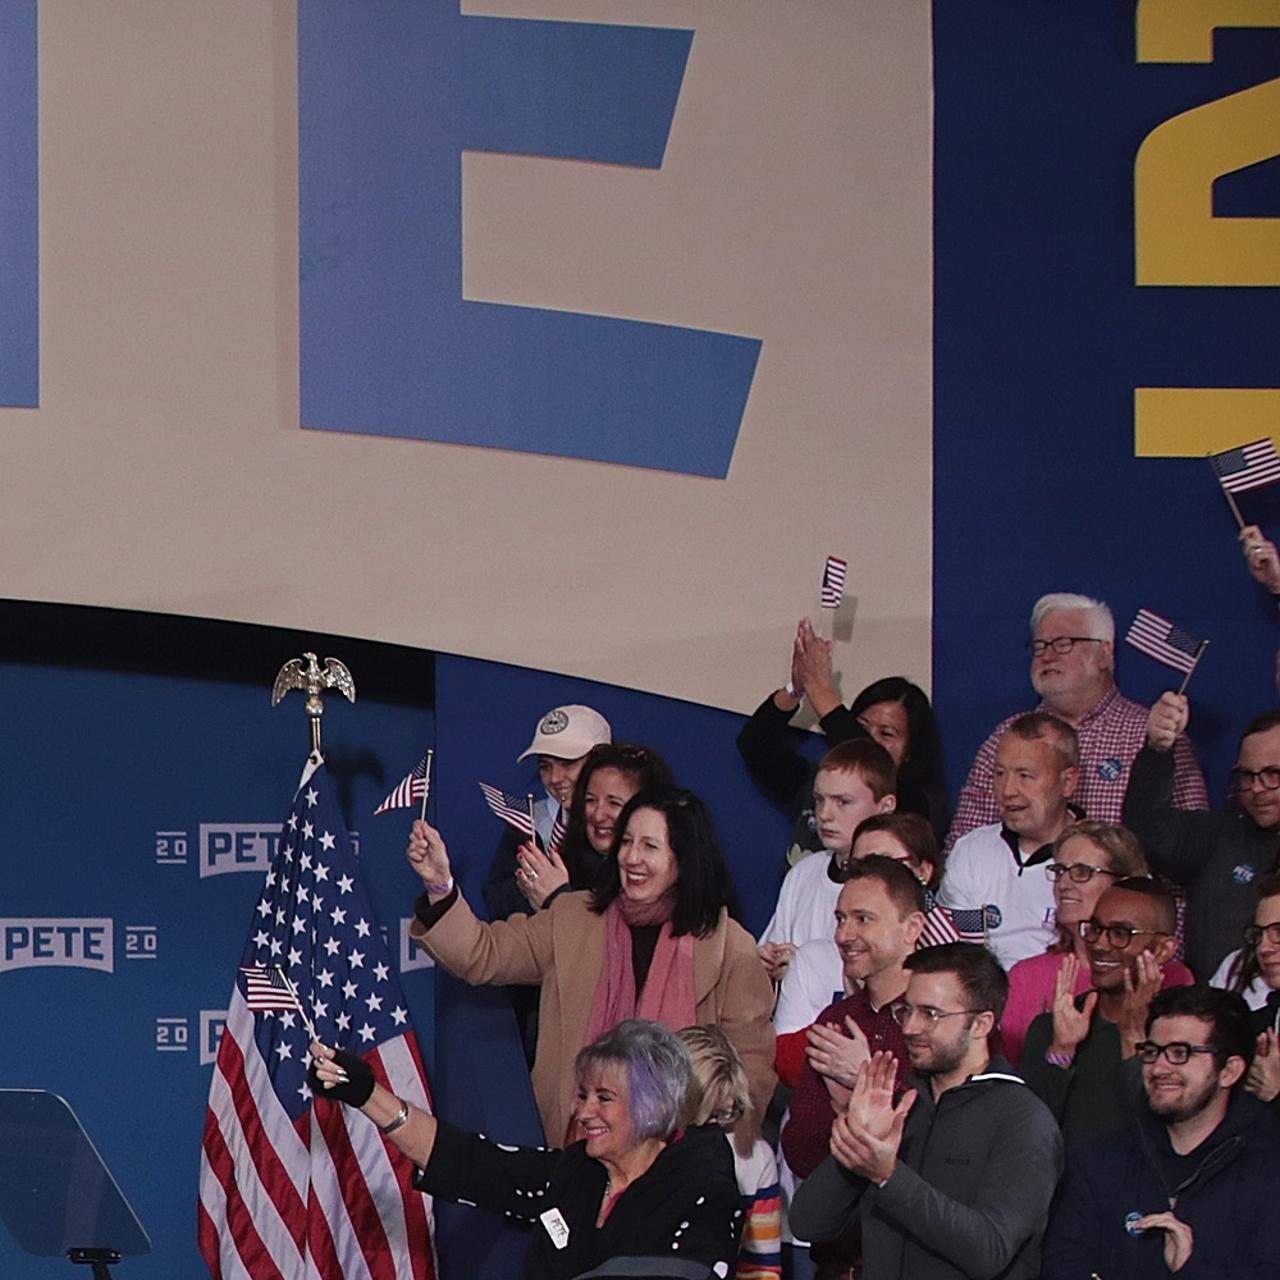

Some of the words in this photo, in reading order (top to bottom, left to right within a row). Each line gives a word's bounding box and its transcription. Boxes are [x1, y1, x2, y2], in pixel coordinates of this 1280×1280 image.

[156, 839, 187, 856] 20
[208, 831, 281, 866] PET
[5, 926, 105, 961] PETE
[126, 934, 156, 951] 20
[157, 1026, 187, 1043] 20
